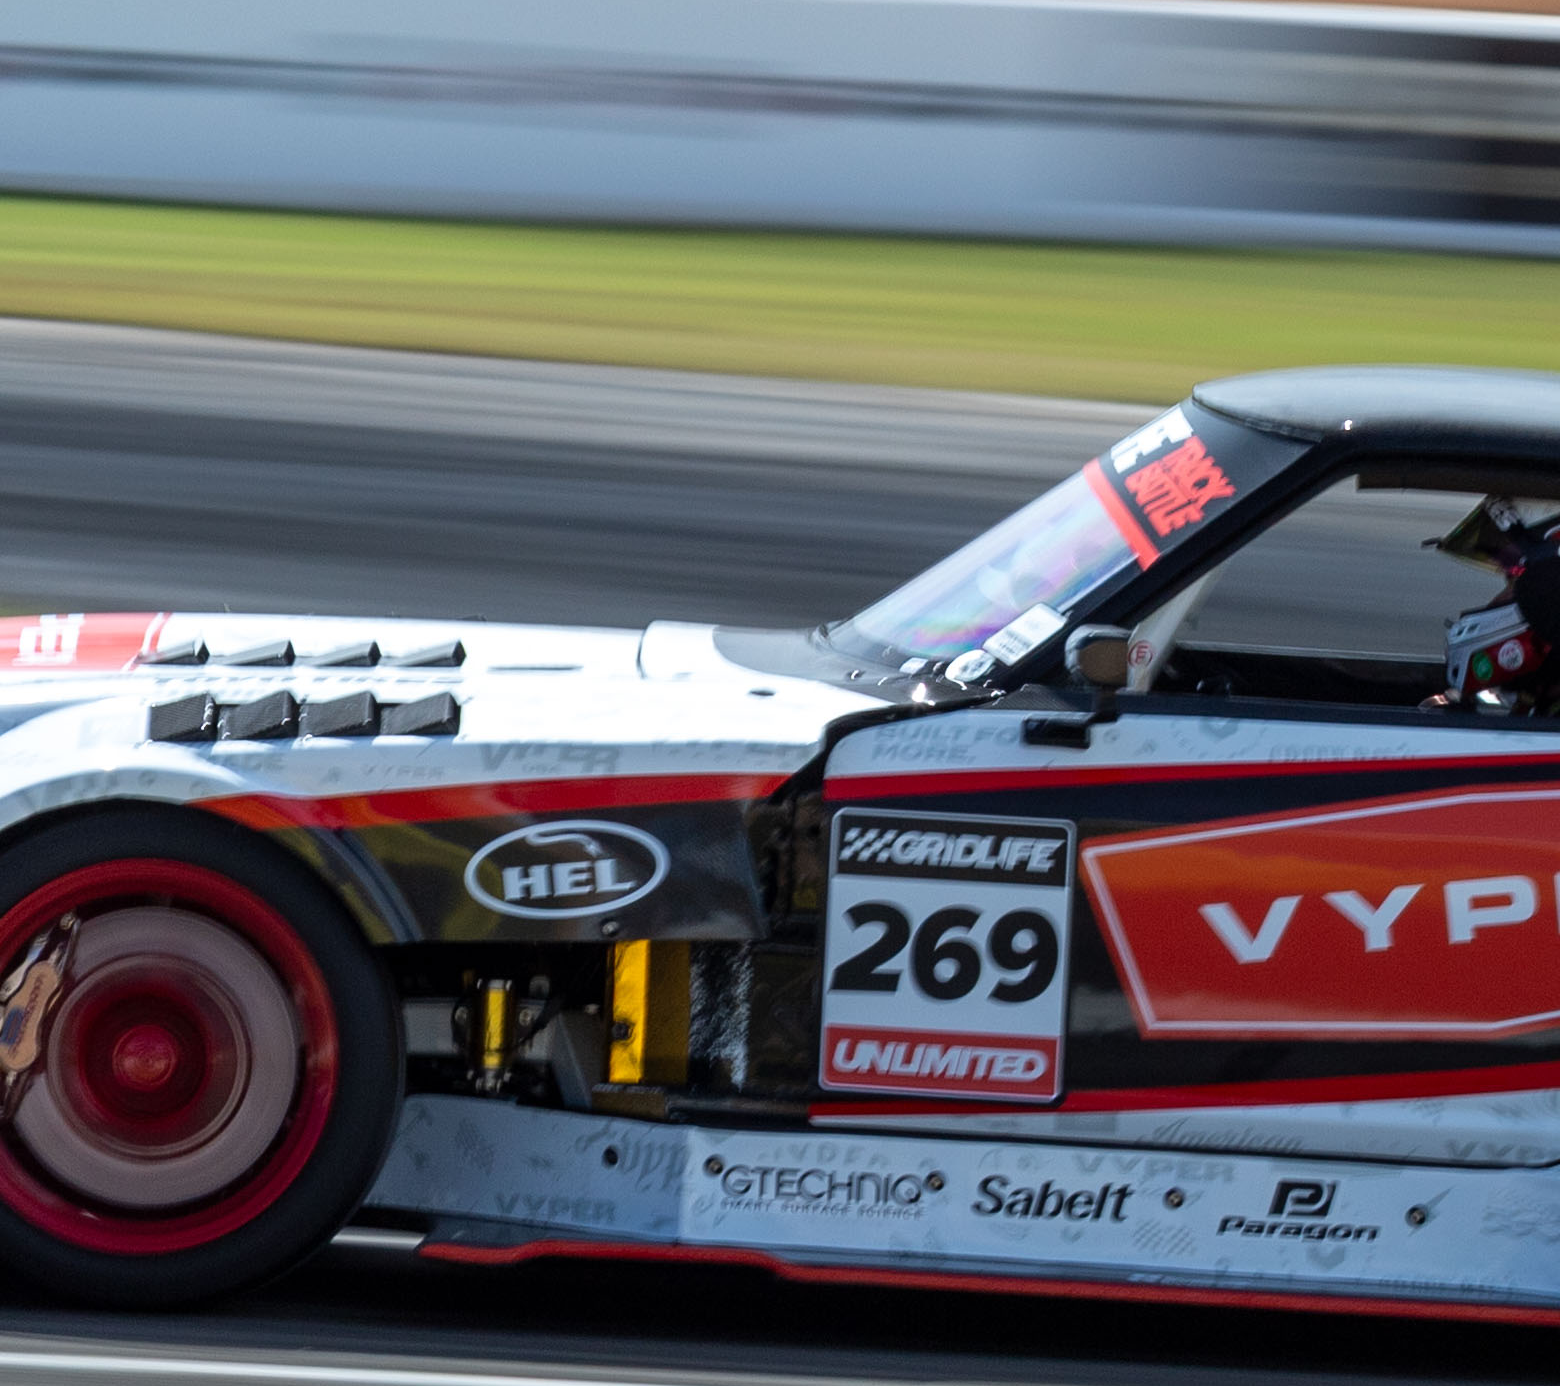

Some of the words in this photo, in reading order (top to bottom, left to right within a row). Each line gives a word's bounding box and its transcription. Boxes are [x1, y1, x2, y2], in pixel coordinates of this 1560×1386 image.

[974, 727, 1020, 746] FO
[890, 829, 1067, 874] GRIDLIFE
[502, 858, 638, 902] HEL
[828, 899, 1060, 1003] 269
[832, 1038, 1051, 1082] UNLIMITED
[721, 1165, 924, 1206] GTECHNIQ
[971, 1174, 1136, 1222] Sabelt
[856, 1204, 927, 1221] SCIENCE
[1216, 1214, 1381, 1243] Paragon
